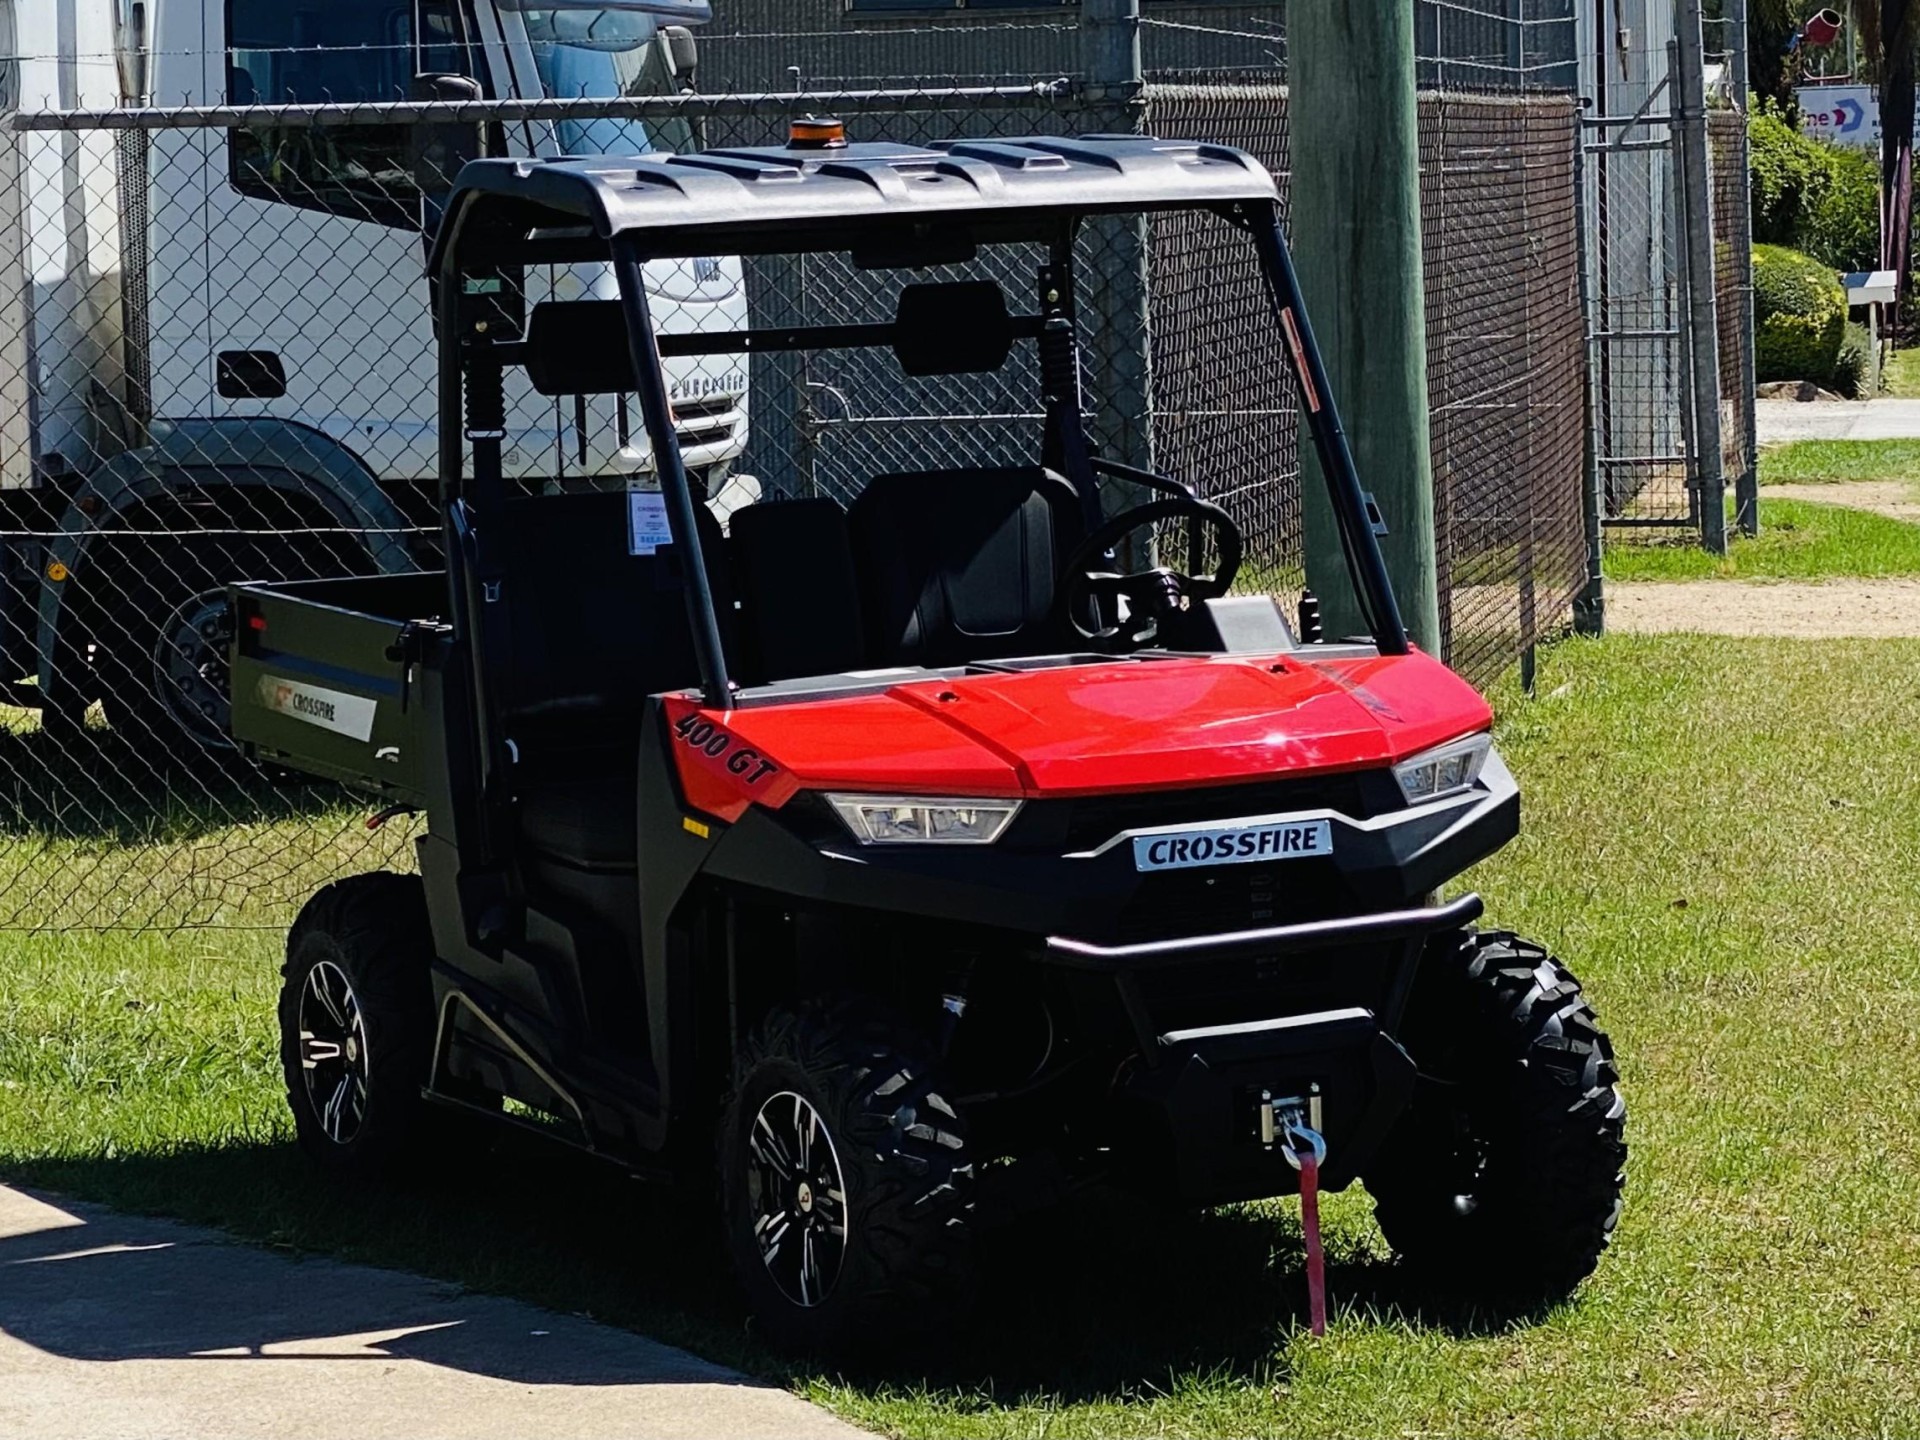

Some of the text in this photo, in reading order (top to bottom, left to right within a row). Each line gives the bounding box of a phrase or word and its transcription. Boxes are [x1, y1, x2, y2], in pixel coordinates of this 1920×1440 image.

[293, 693, 335, 721] CROSSFIRE
[673, 713, 779, 785] 400 GT
[1148, 826, 1318, 865] CROSSFIRE
